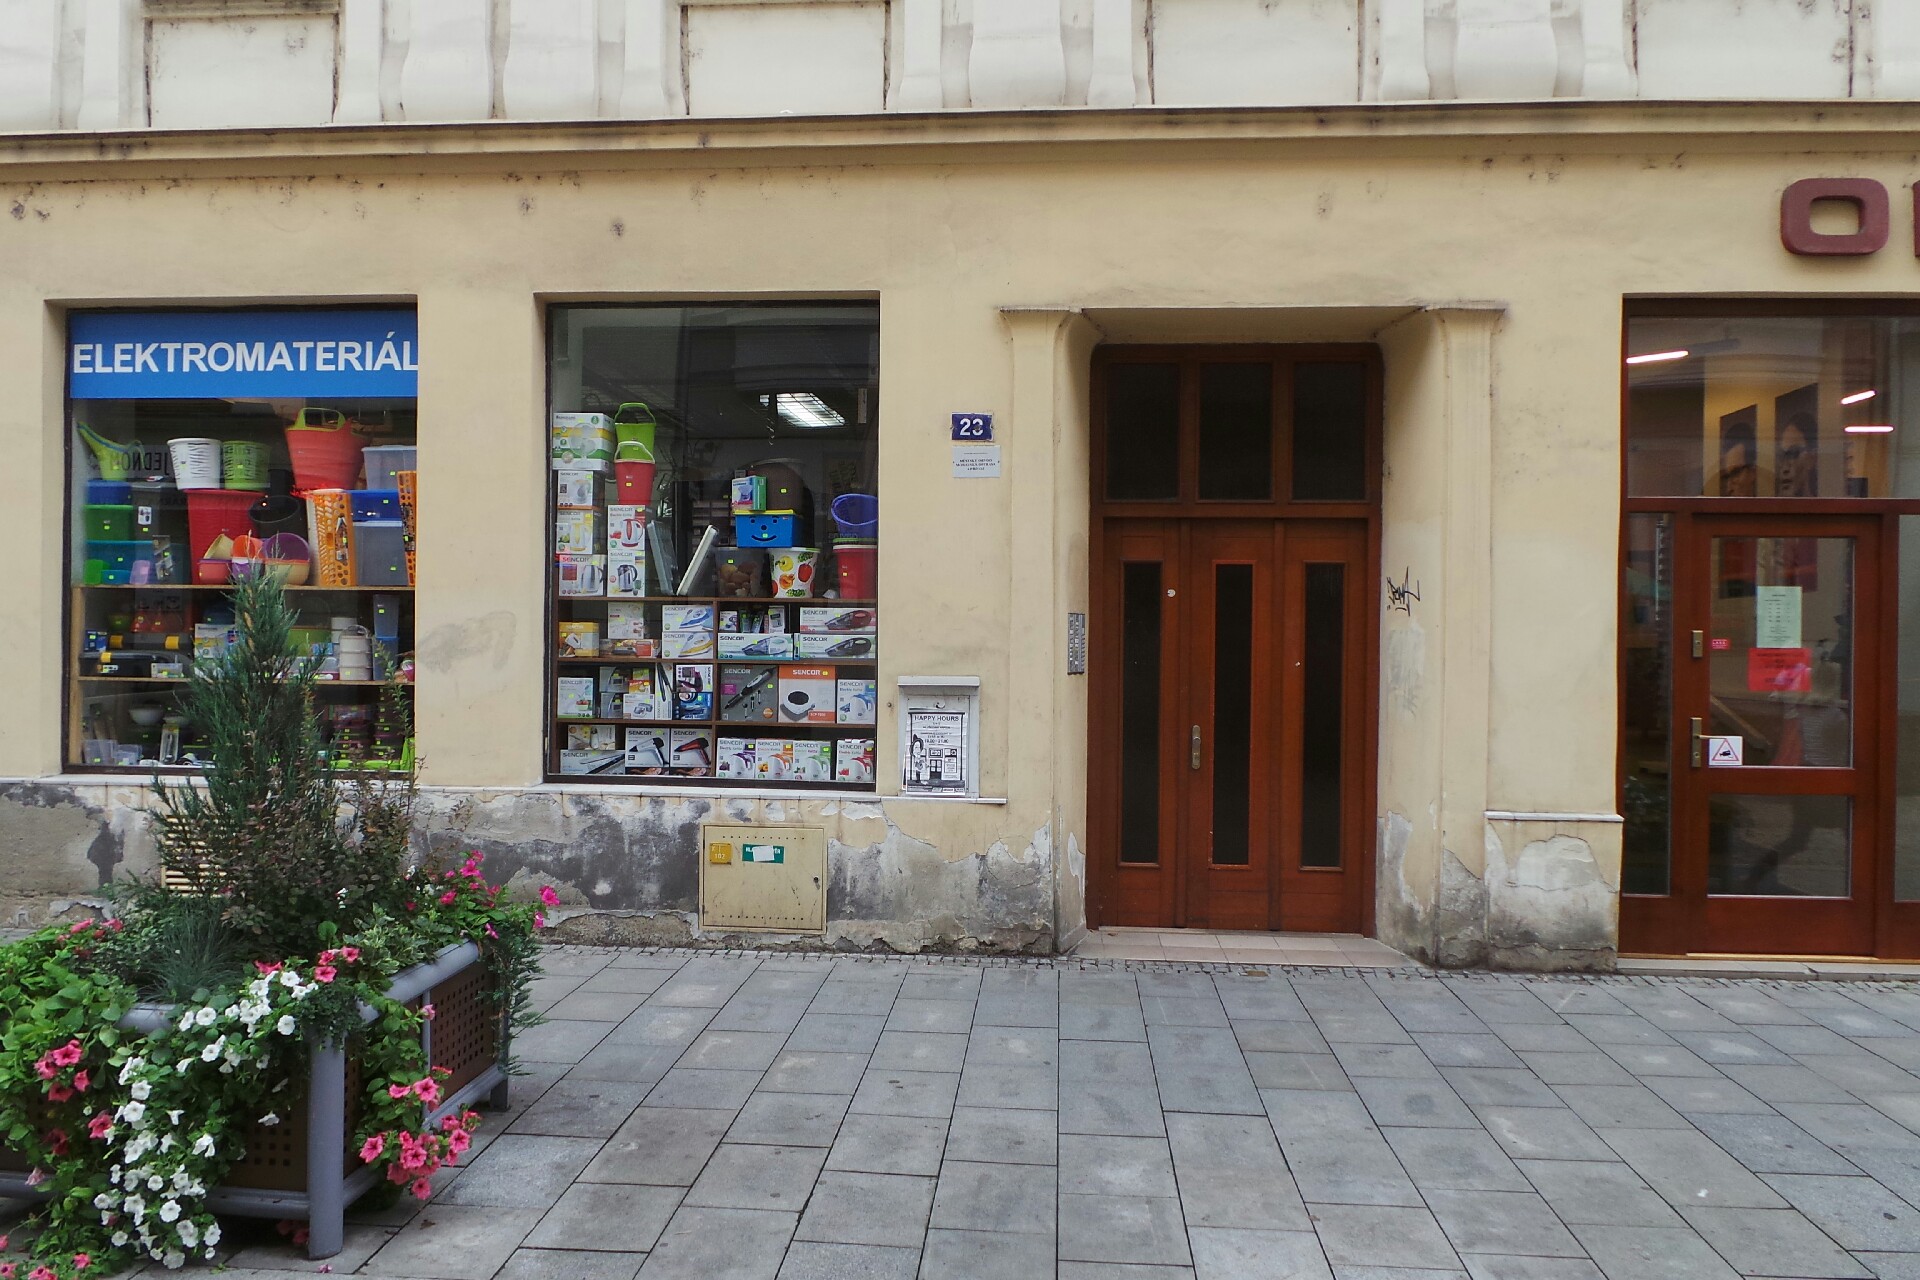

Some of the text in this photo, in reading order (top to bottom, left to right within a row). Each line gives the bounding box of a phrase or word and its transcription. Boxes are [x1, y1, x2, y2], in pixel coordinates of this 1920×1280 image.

[1780, 177, 1920, 257] O
[73, 331, 418, 374] ELEKTROMATERIÁL
[960, 418, 983, 436] 23
